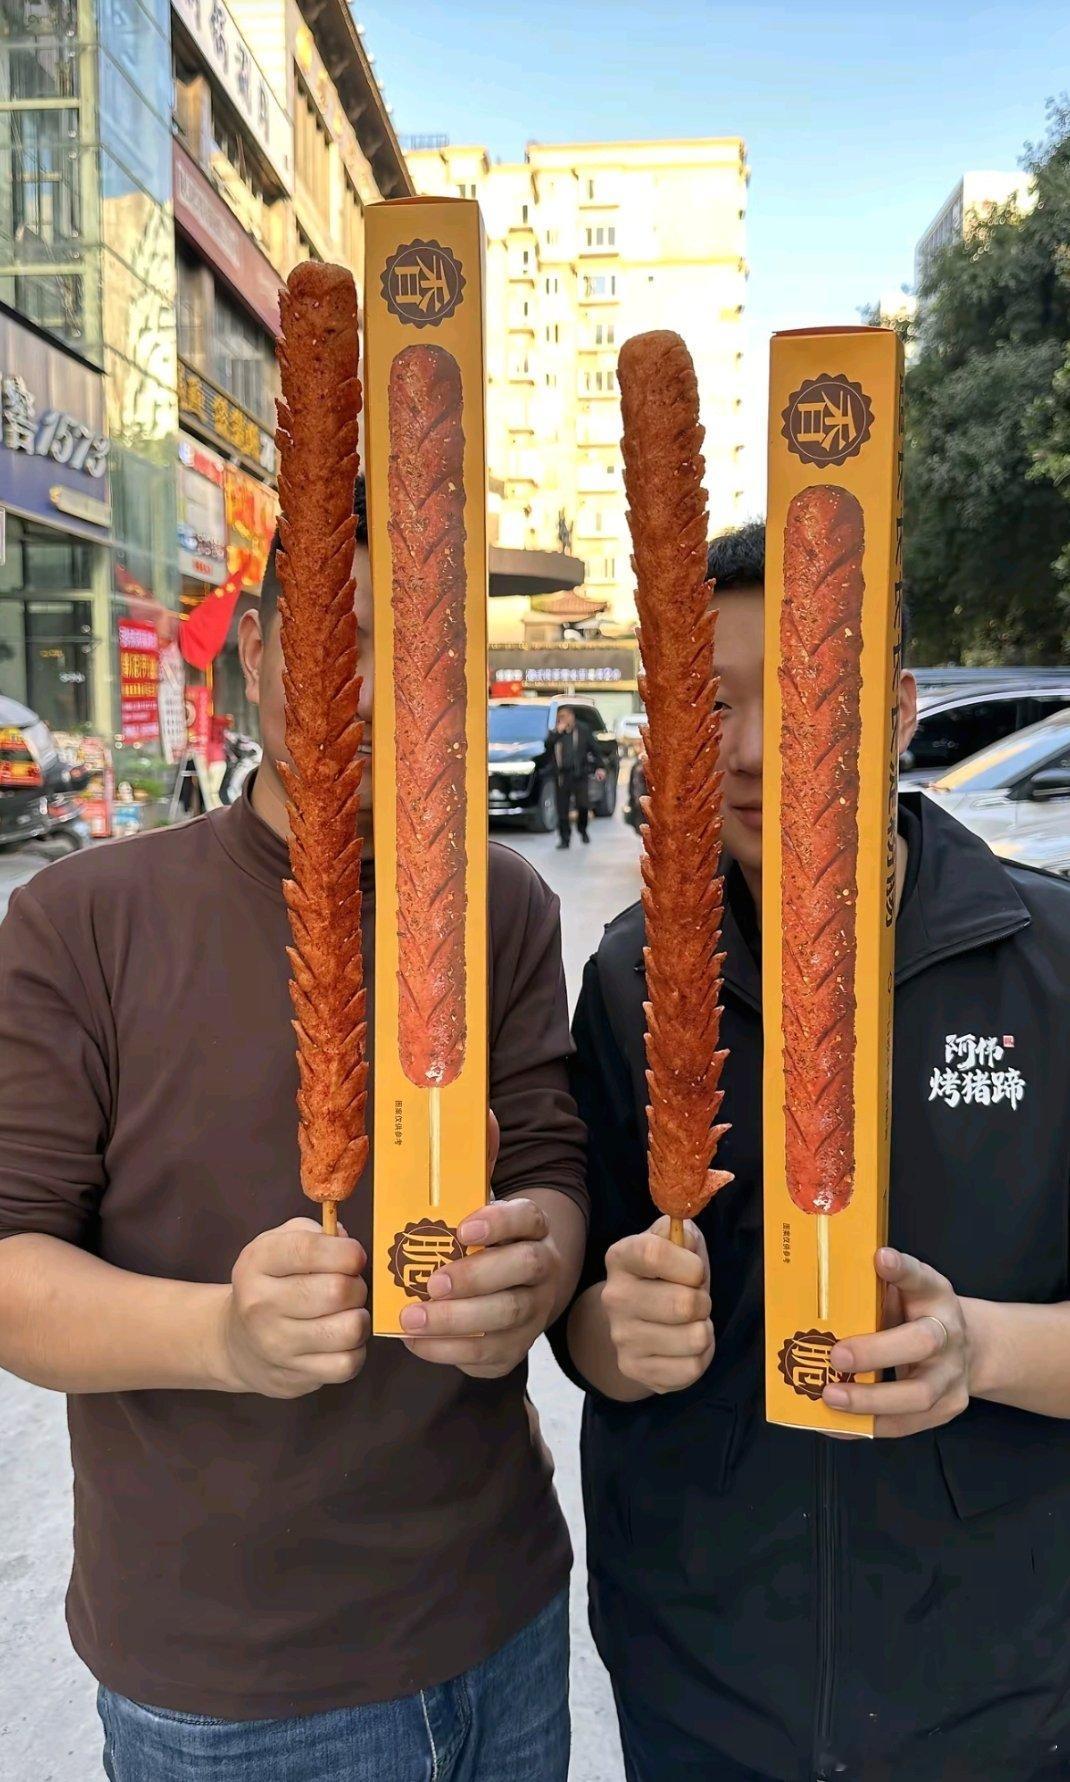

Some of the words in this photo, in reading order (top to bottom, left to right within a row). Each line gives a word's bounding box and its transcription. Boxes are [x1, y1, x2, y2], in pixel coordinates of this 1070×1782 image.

[394, 255, 451, 313] 香
[796, 390, 857, 452] 香
[928, 1067, 1026, 1111] 烤猪蹄
